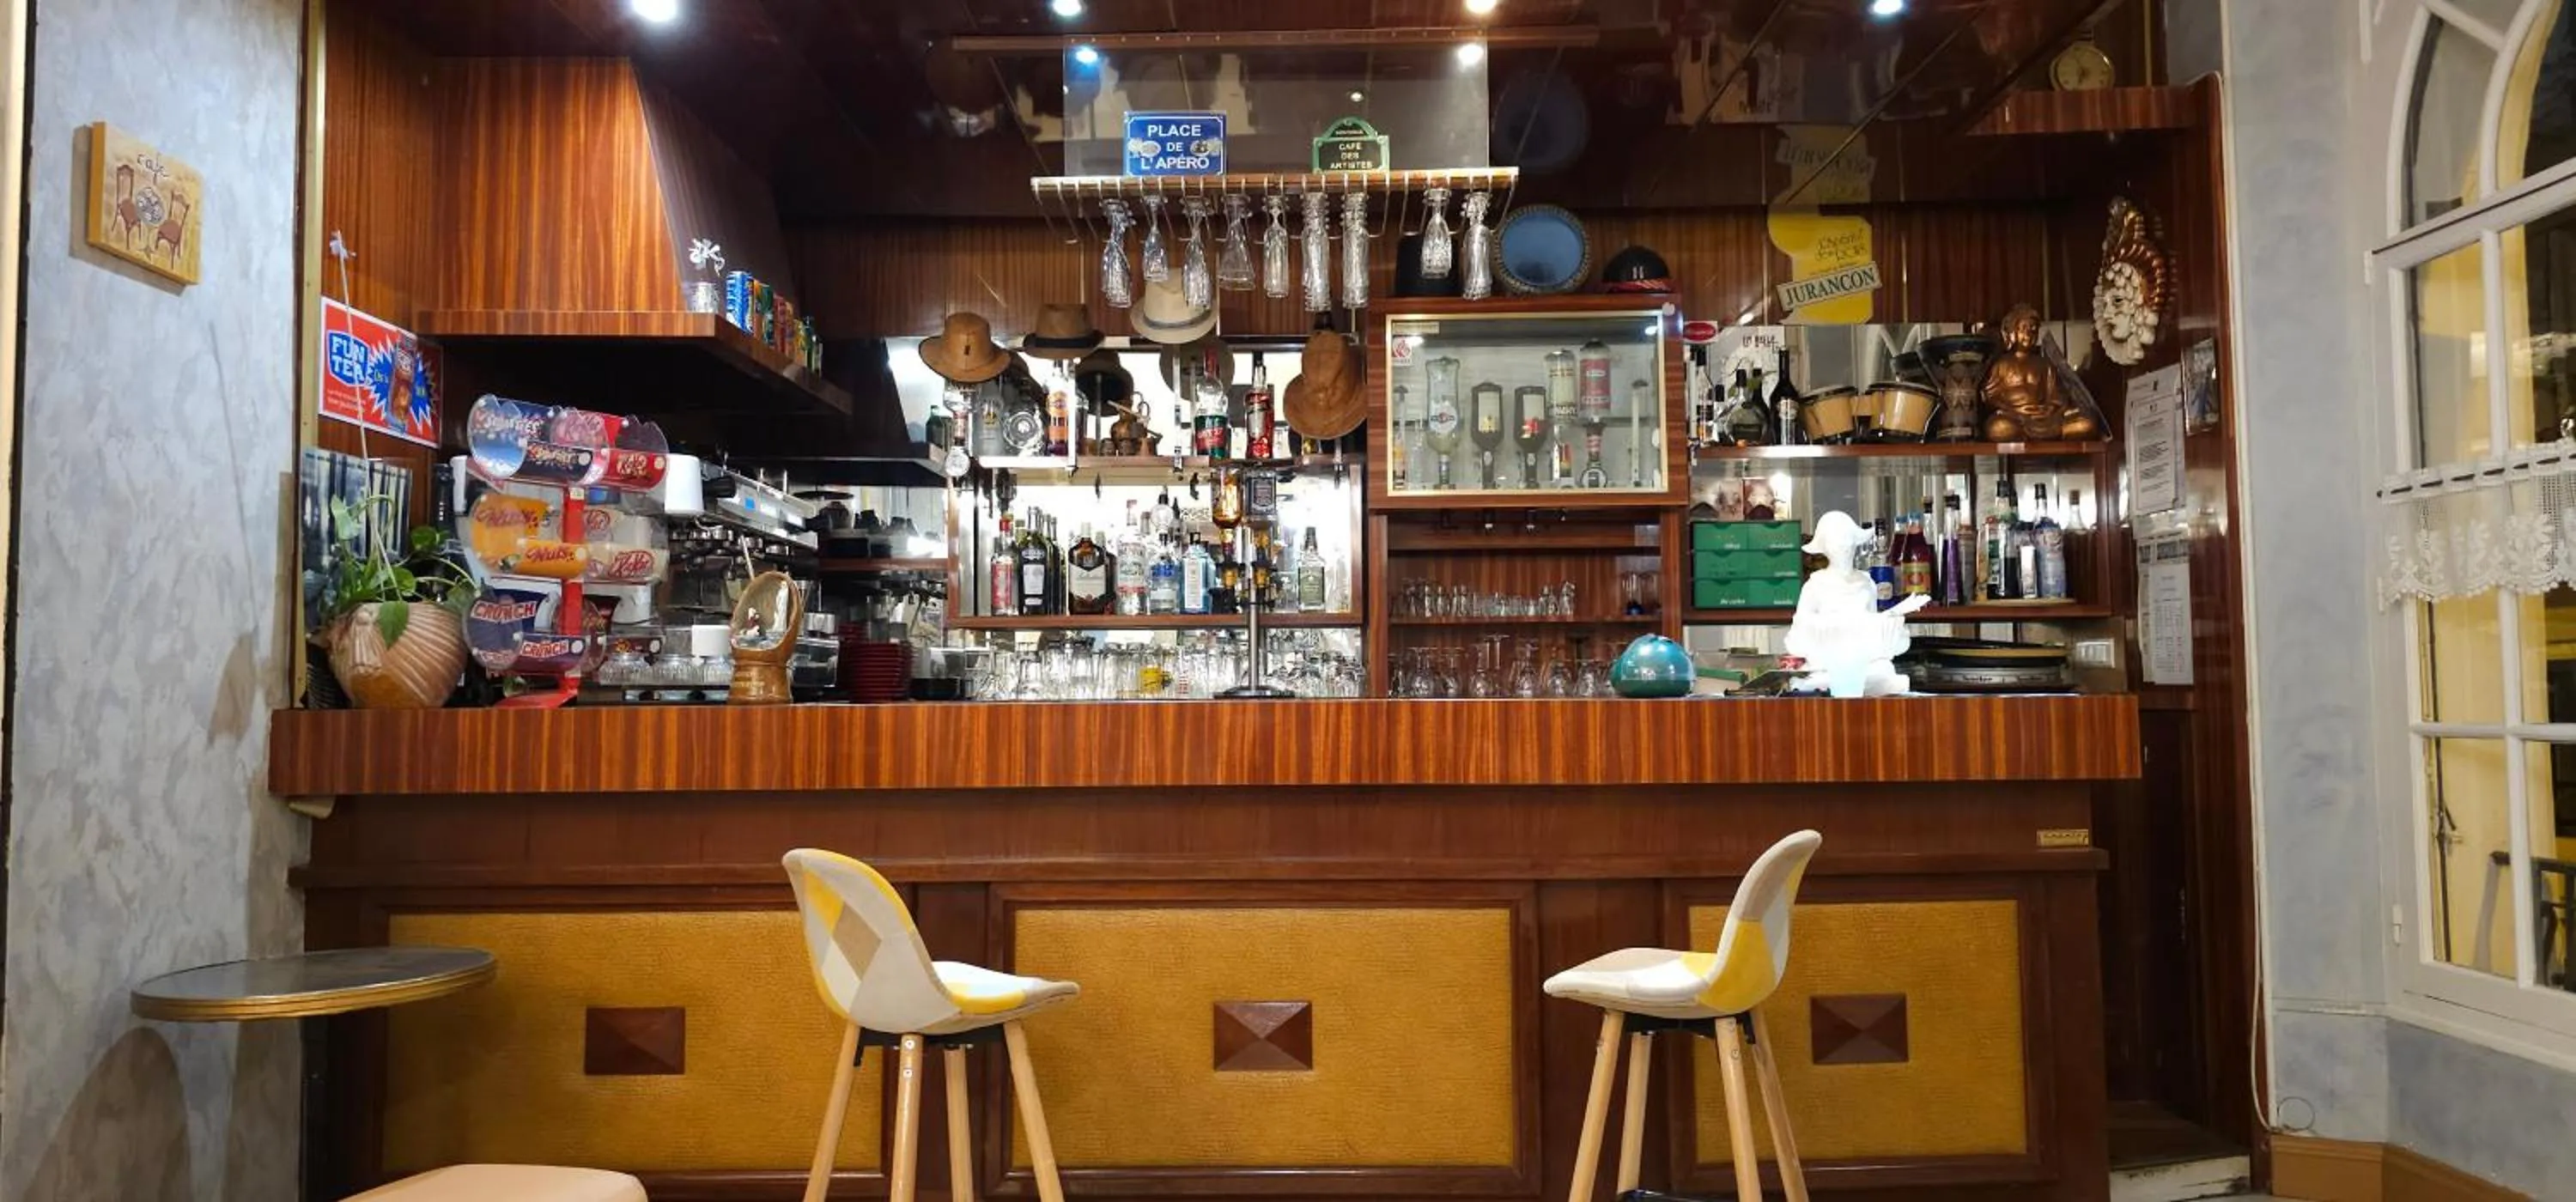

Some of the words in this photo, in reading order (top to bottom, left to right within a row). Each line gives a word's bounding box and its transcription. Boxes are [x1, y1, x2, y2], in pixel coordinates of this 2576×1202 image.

[1147, 124, 1201, 137] PLACE
[1166, 142, 1183, 152] DE
[1140, 153, 1209, 169] L'APÉRO
[331, 337, 366, 364] FUN
[331, 355, 365, 383] TEA
[471, 600, 537, 623] CRUNCH
[520, 640, 569, 659] CRUNCH
